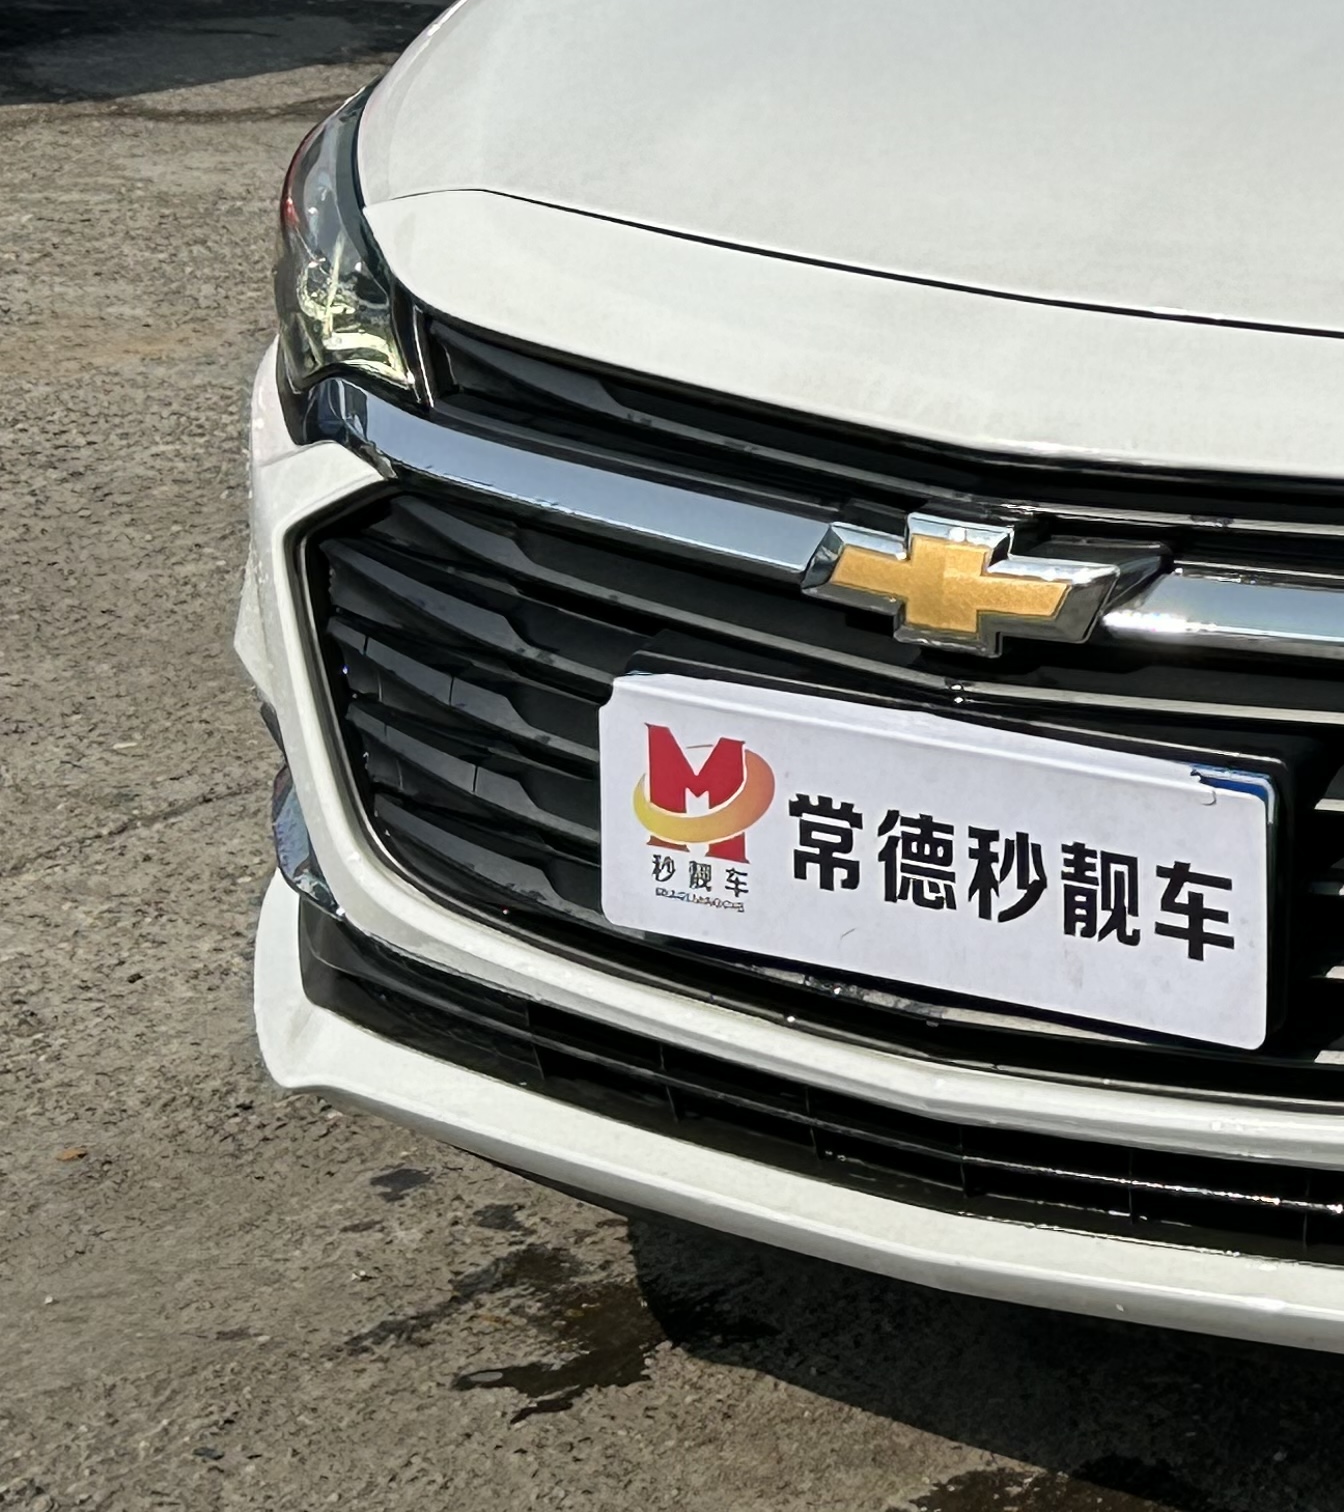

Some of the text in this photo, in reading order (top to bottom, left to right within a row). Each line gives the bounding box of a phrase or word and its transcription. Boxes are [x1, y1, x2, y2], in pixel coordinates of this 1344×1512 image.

[789, 793, 1236, 963] 常德秒靓车
